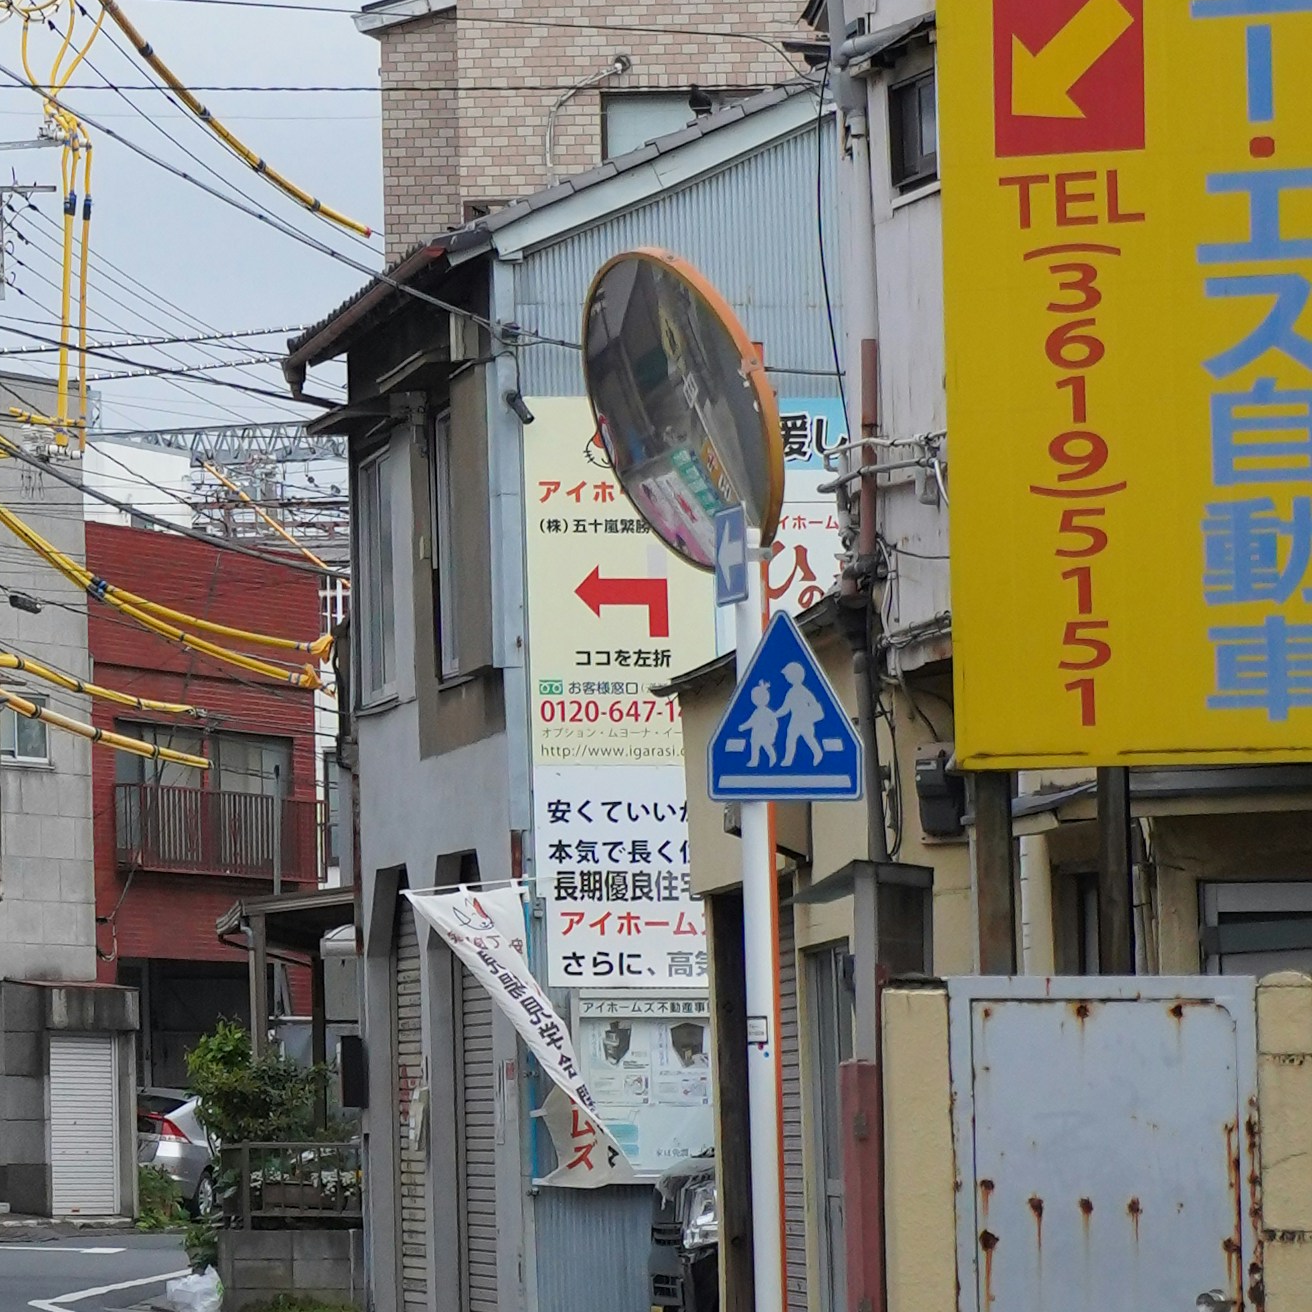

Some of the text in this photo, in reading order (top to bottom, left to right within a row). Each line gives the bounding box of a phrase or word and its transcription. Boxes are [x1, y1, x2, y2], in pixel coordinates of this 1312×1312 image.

[998, 169, 1146, 231] TEL
[538, 480, 625, 503] アイホ
[1022, 242, 1128, 729] (3619)5151
[575, 649, 671, 668] ココを左折
[568, 681, 639, 694] お客様窓口
